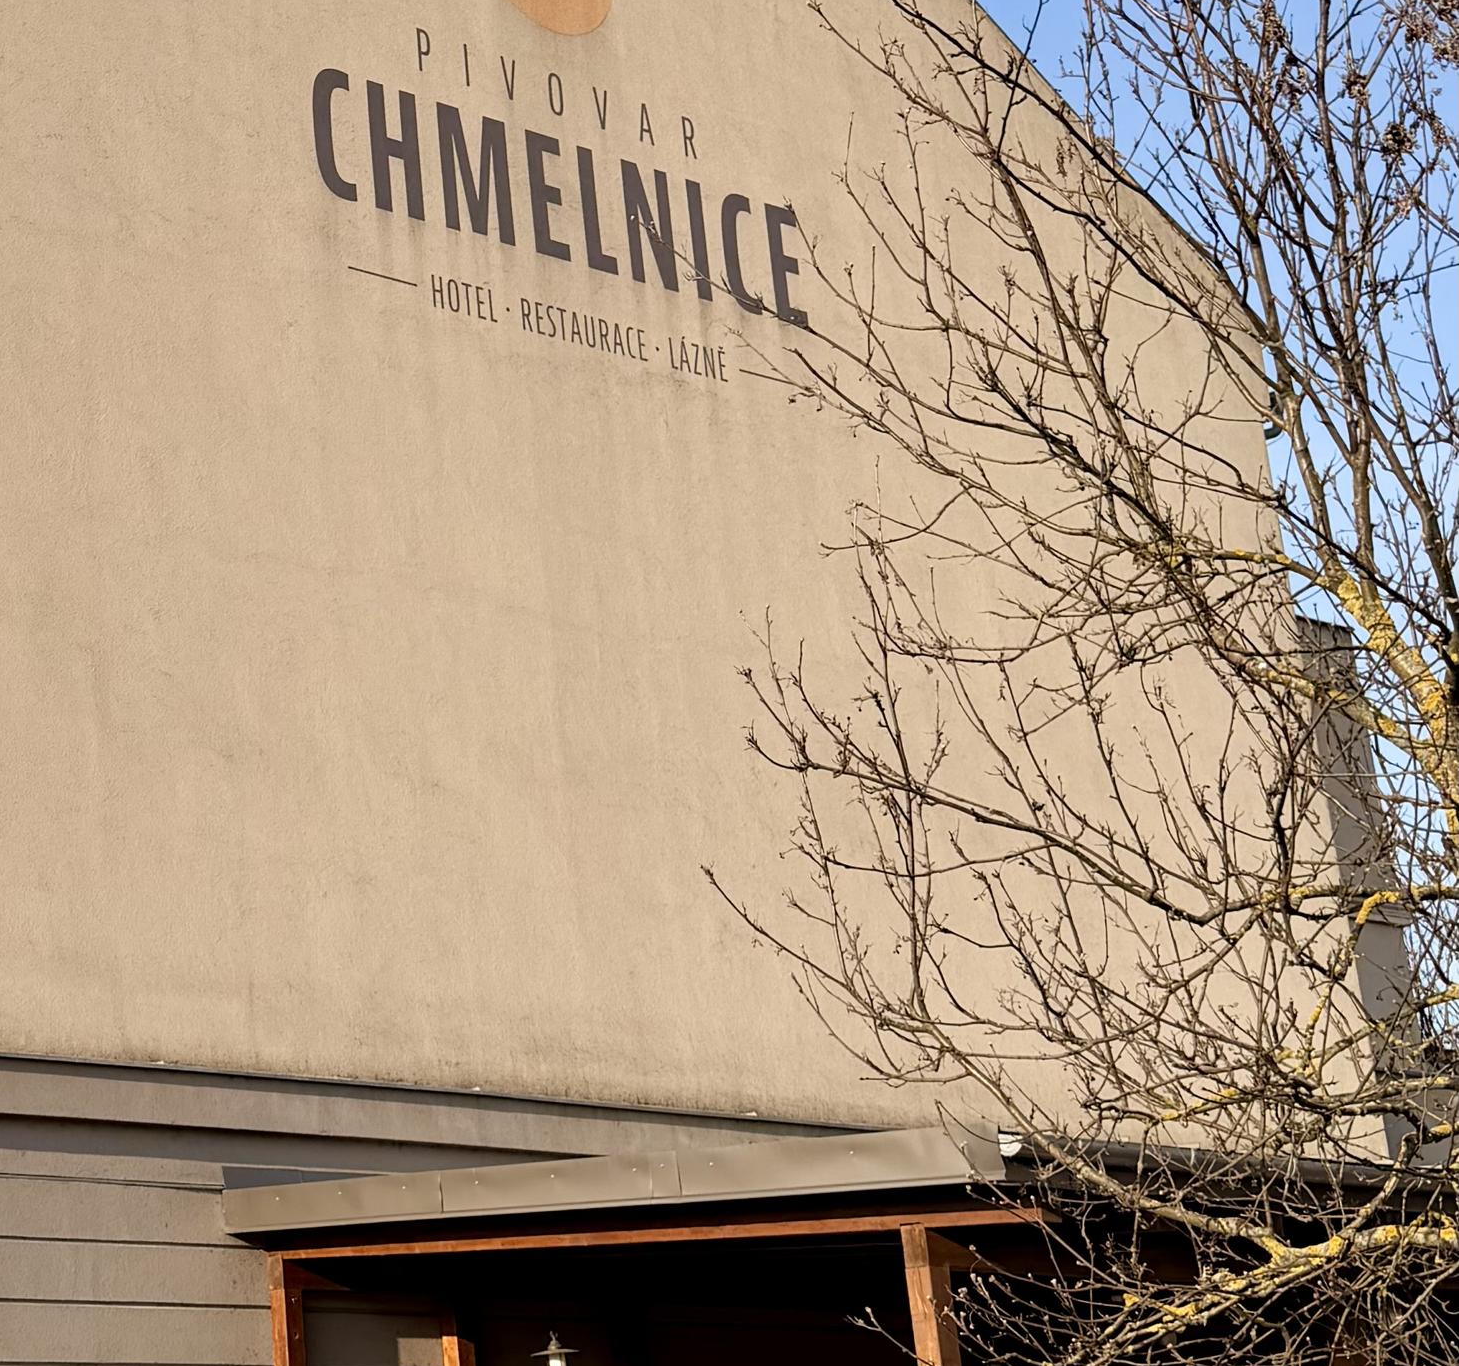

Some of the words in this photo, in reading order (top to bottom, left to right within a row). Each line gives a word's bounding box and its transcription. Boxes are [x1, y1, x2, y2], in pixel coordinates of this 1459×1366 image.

[415, 27, 698, 160] PIVOVAR
[311, 67, 809, 328] CHMELNICE
[430, 274, 499, 324] HOTEL
[519, 297, 649, 363] RESTAURACE
[667, 335, 729, 383] LÁZNĚ
